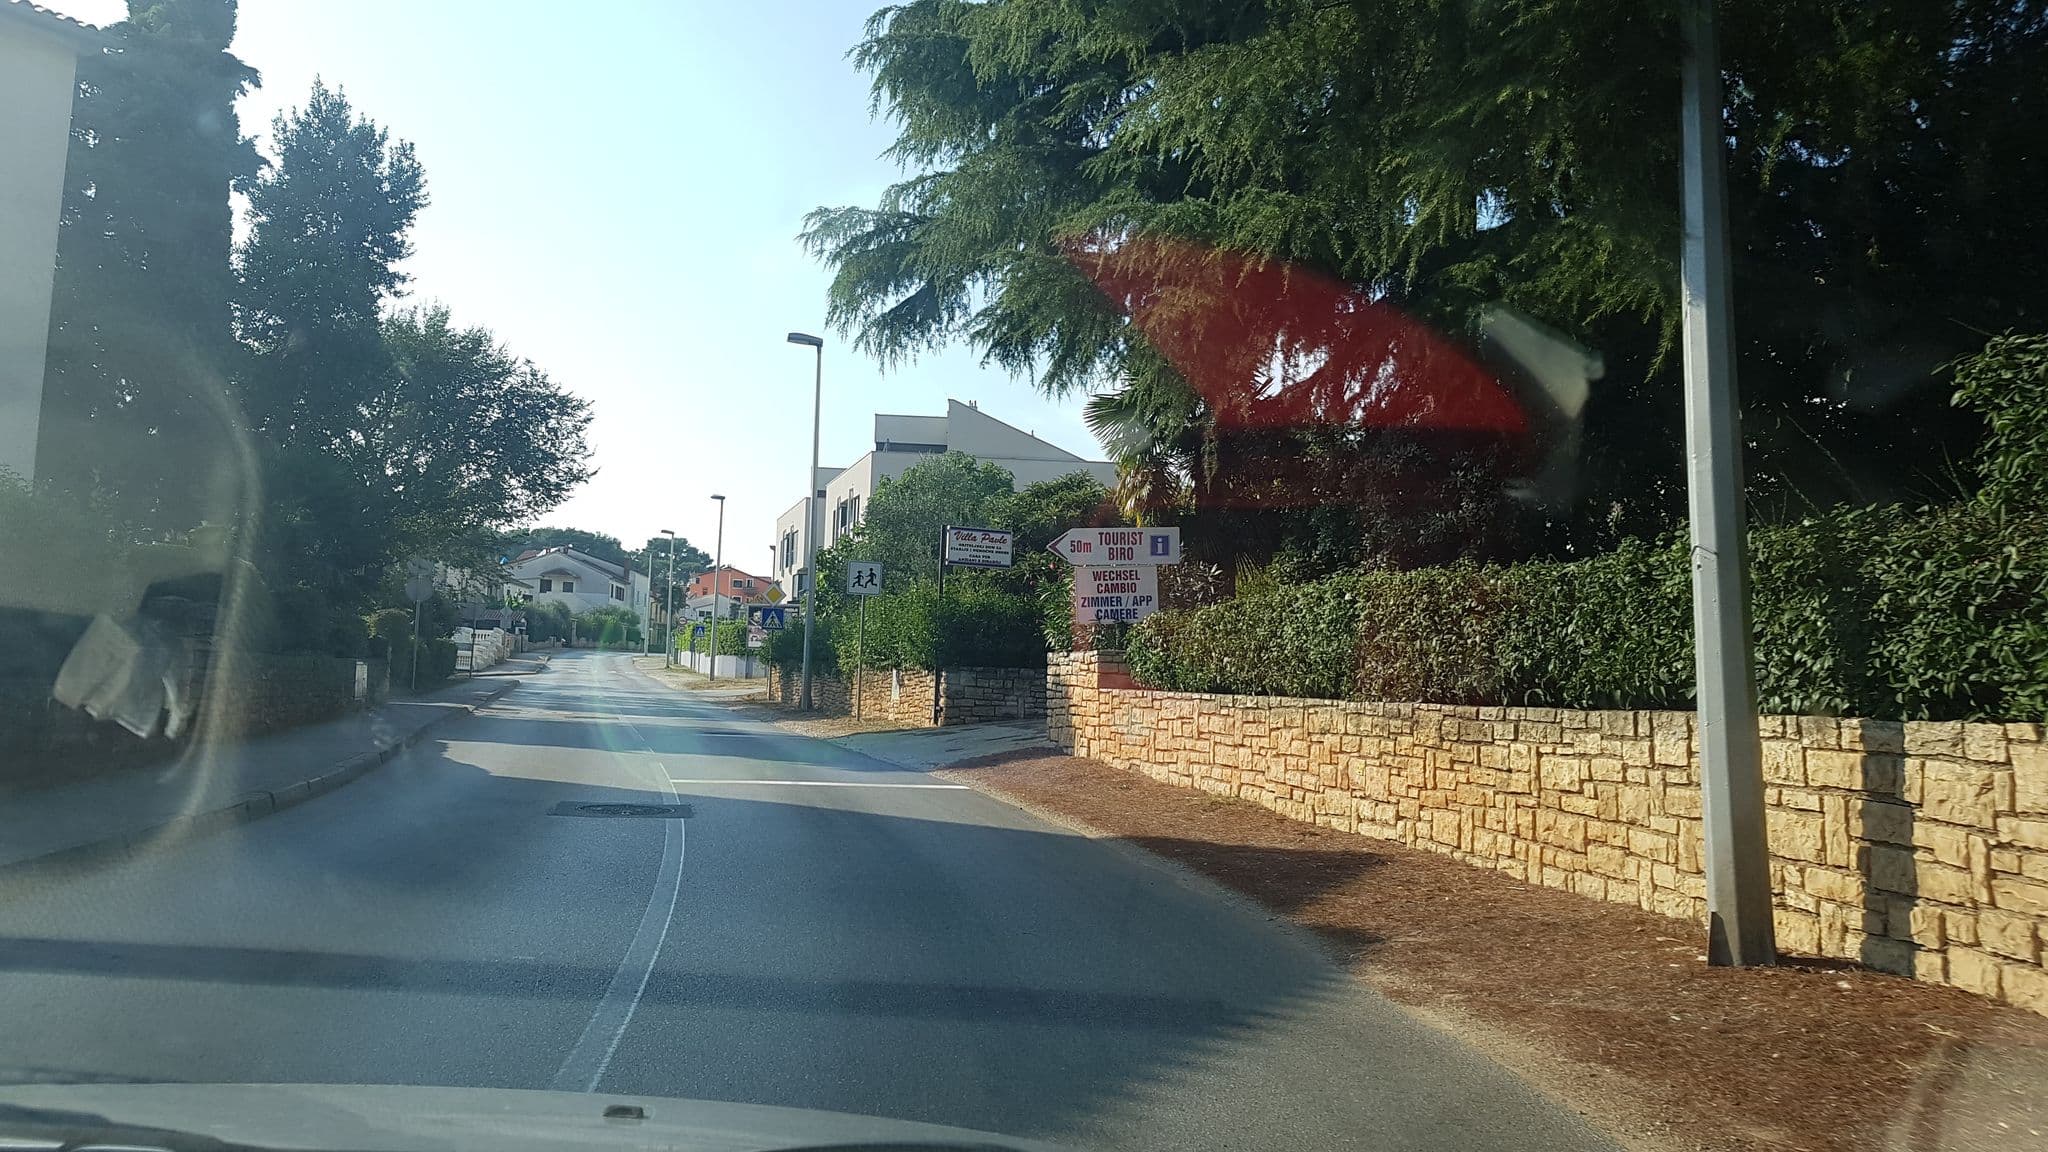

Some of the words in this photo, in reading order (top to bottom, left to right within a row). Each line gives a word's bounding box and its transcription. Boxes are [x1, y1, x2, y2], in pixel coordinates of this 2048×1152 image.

[954, 530, 977, 542] Villa
[1098, 532, 1144, 546] TOURIST
[1070, 540, 1092, 553] 50m
[1108, 547, 1134, 561] BIRO
[1092, 570, 1141, 581] WECHSEL
[1097, 582, 1137, 594] CAMBIO
[1081, 596, 1122, 608] ZIMMER
[1132, 595, 1153, 607] APP
[1096, 609, 1139, 620] CAMERE
